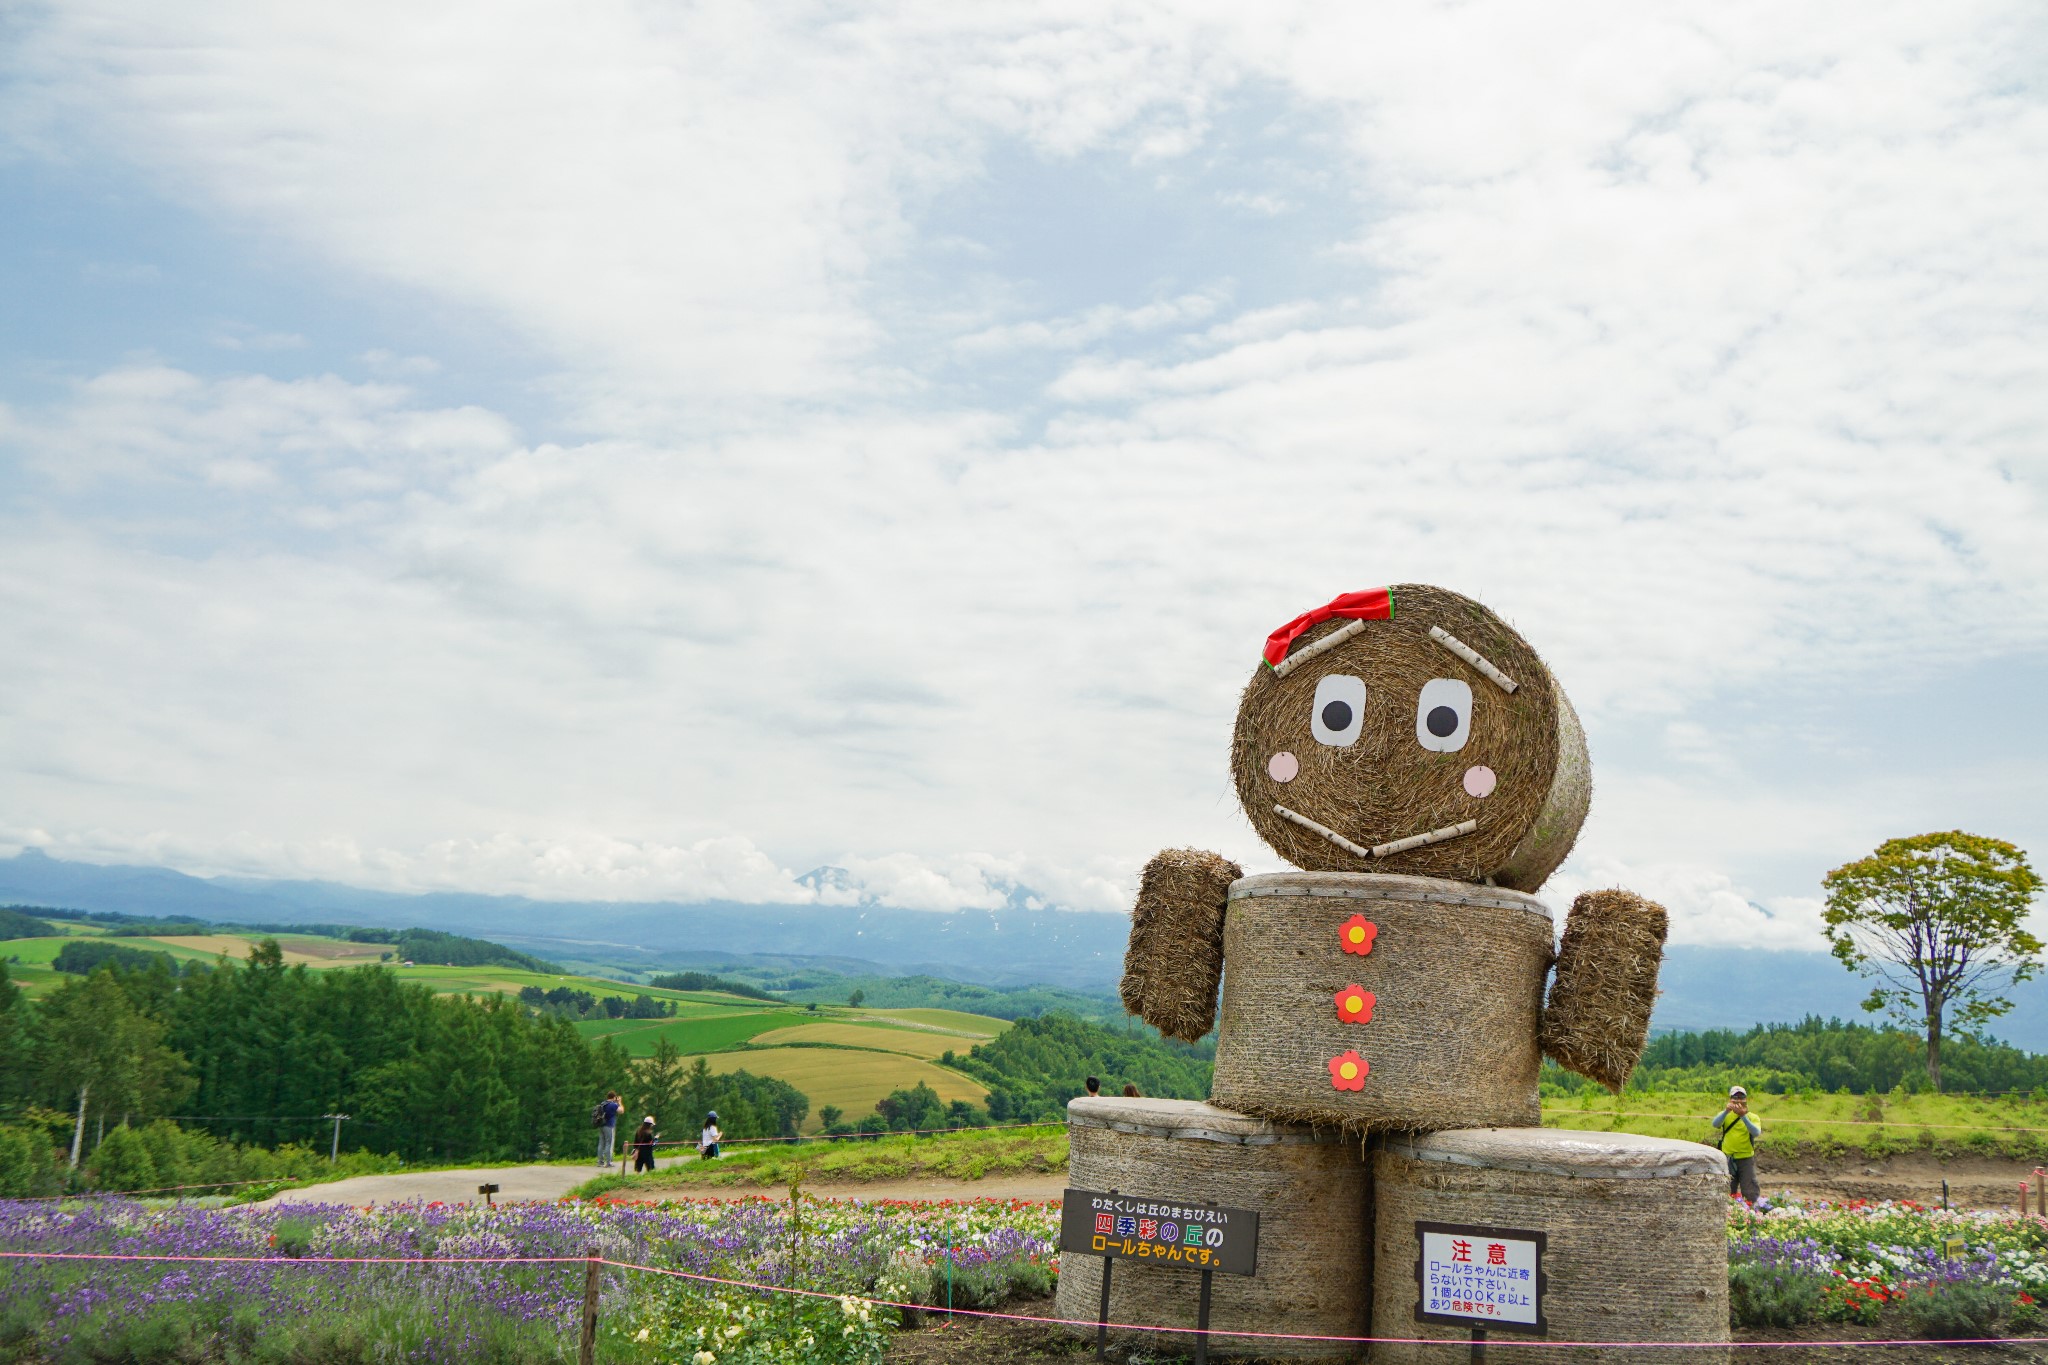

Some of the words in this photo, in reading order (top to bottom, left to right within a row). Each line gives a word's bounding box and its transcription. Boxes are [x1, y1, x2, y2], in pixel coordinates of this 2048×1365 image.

[1092, 1197, 1227, 1224] わたくしは丘のまちびえい
[1095, 1213, 1224, 1248] 四季彩の丘の
[1092, 1235, 1220, 1266] ロールちゃんです。
[1452, 1240, 1507, 1265] 注意
[1430, 1261, 1530, 1281] ロールちゃんに近寄
[1430, 1273, 1516, 1292] らないで下さい。
[1430, 1299, 1501, 1316] あり危険です。
